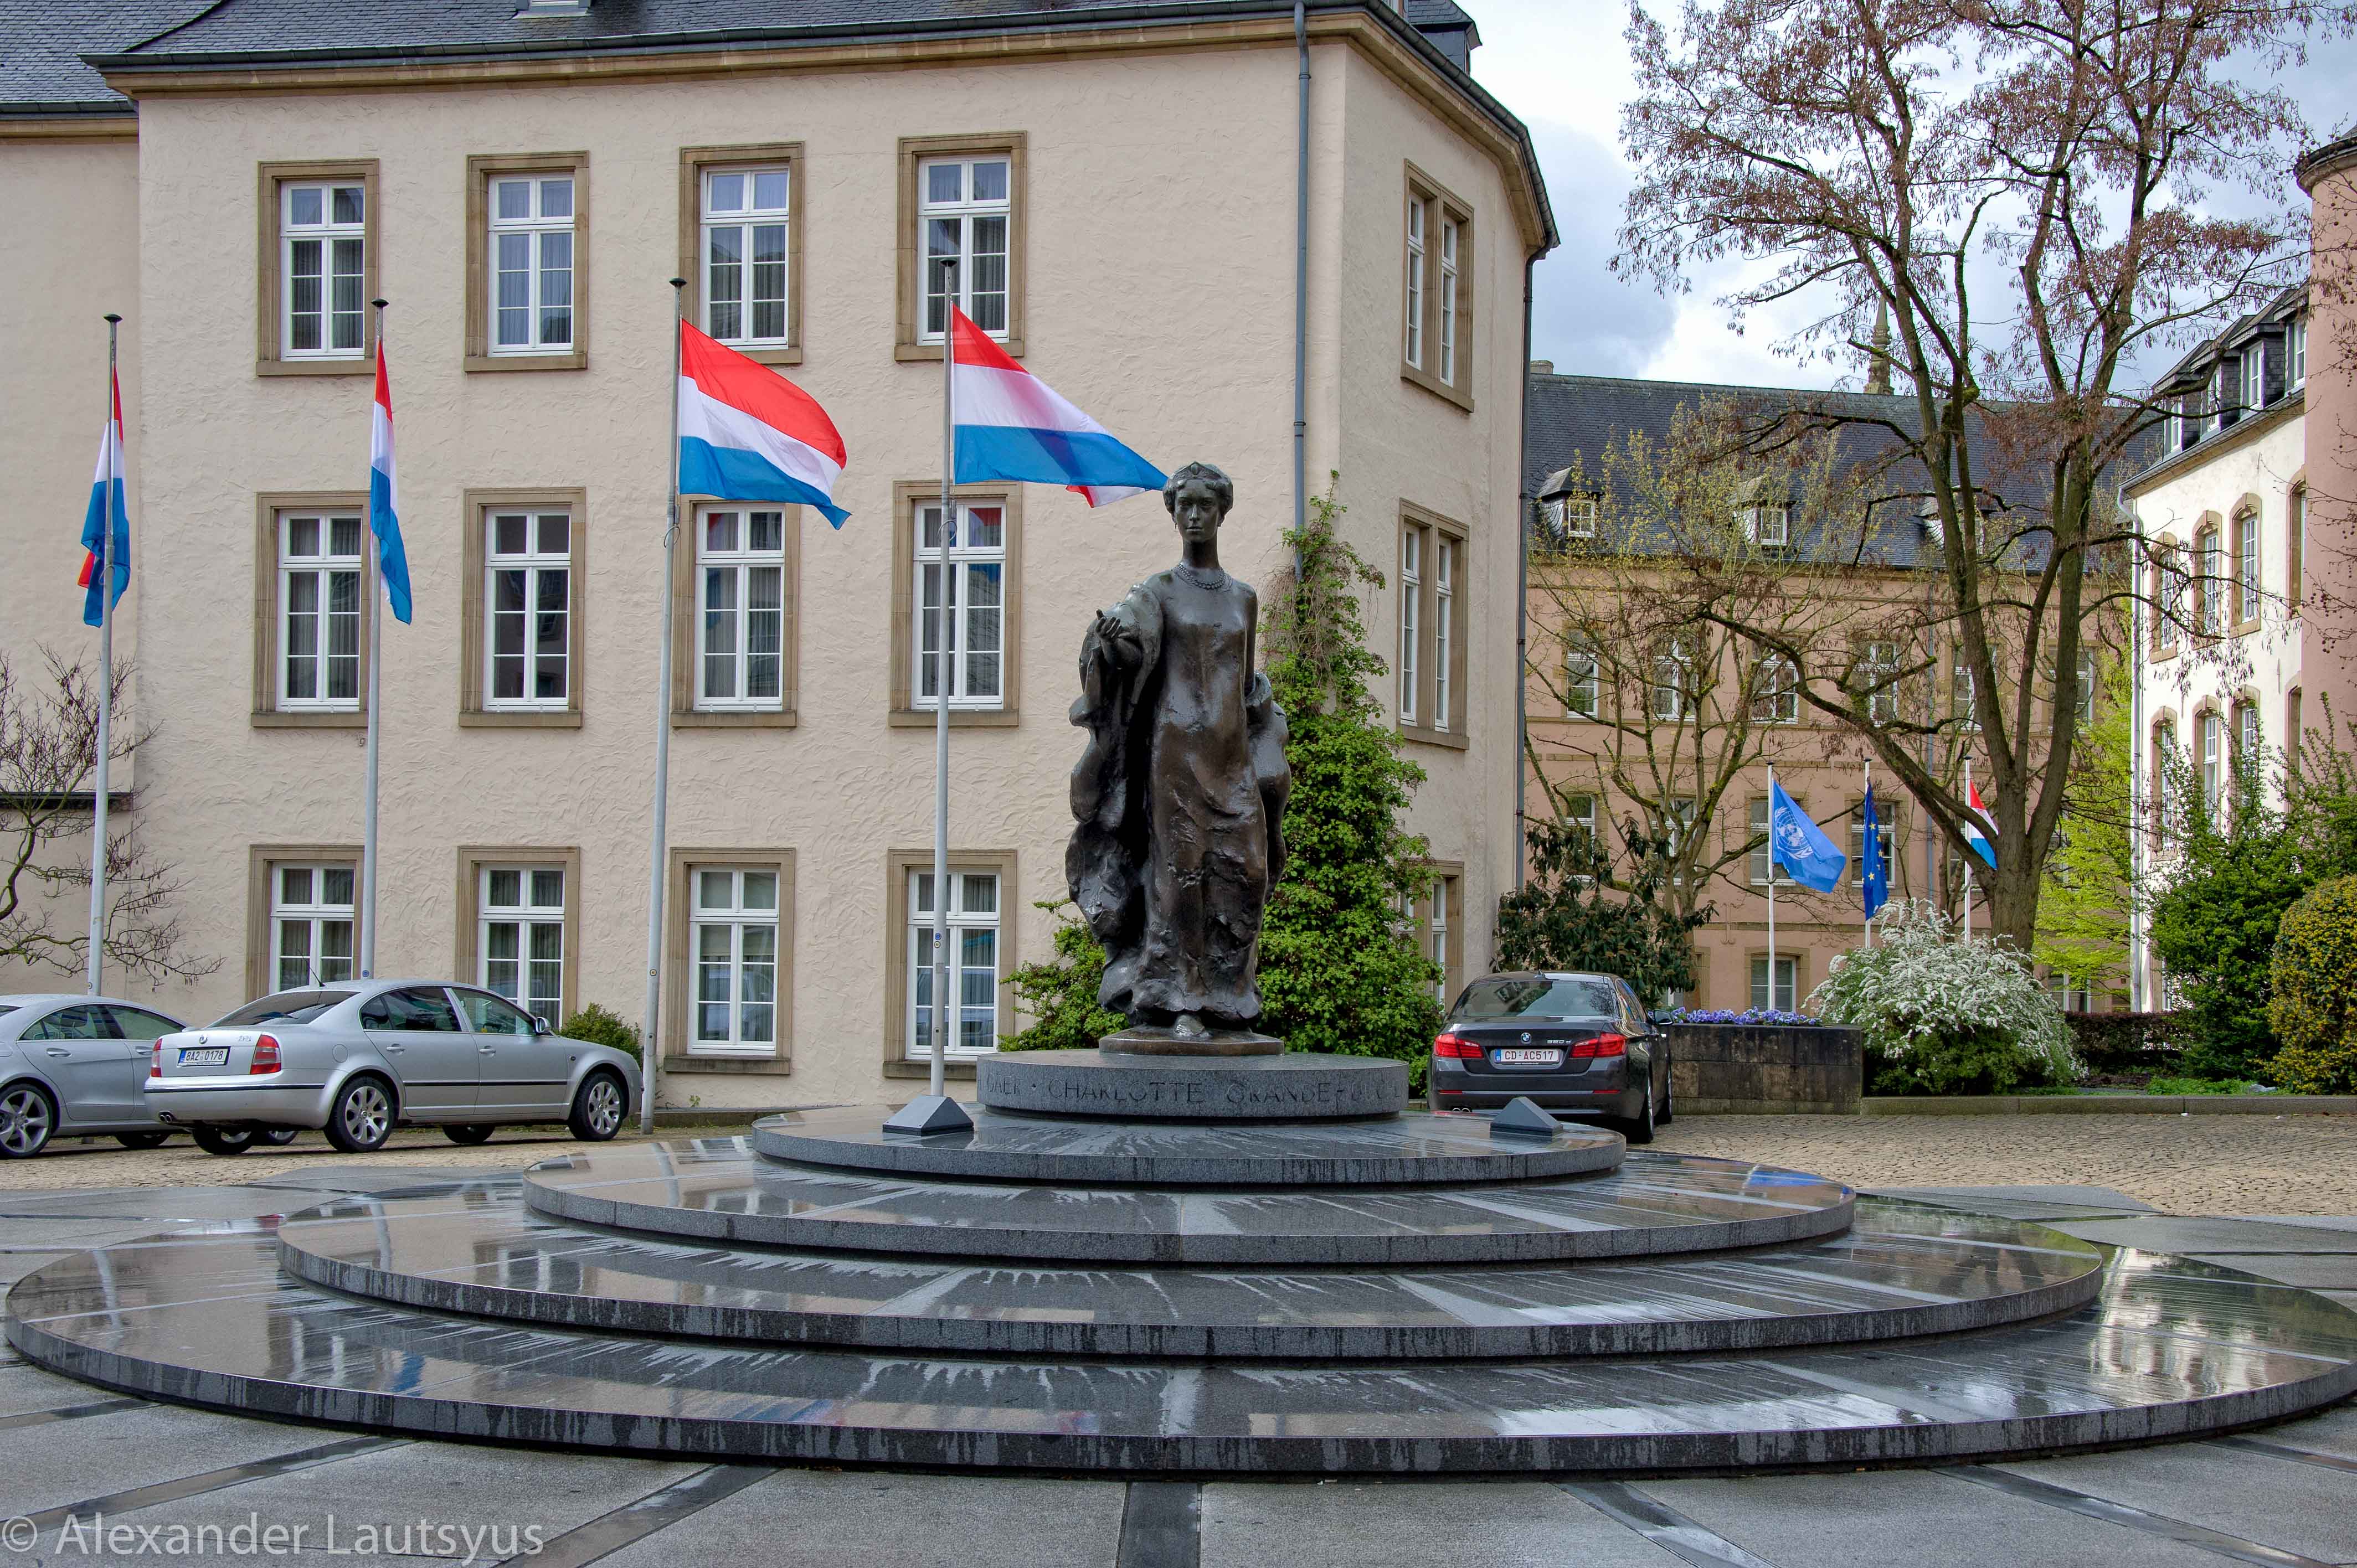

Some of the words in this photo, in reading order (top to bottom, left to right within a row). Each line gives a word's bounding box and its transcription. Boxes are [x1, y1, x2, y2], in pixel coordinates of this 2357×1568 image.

[186, 1051, 200, 1061] 8A2
[204, 1050, 224, 1061] 0178
[1505, 1051, 1517, 1060] CD
[1524, 1050, 1554, 1060] AC517
[1048, 1079, 1206, 1103] CHARLOTTE
